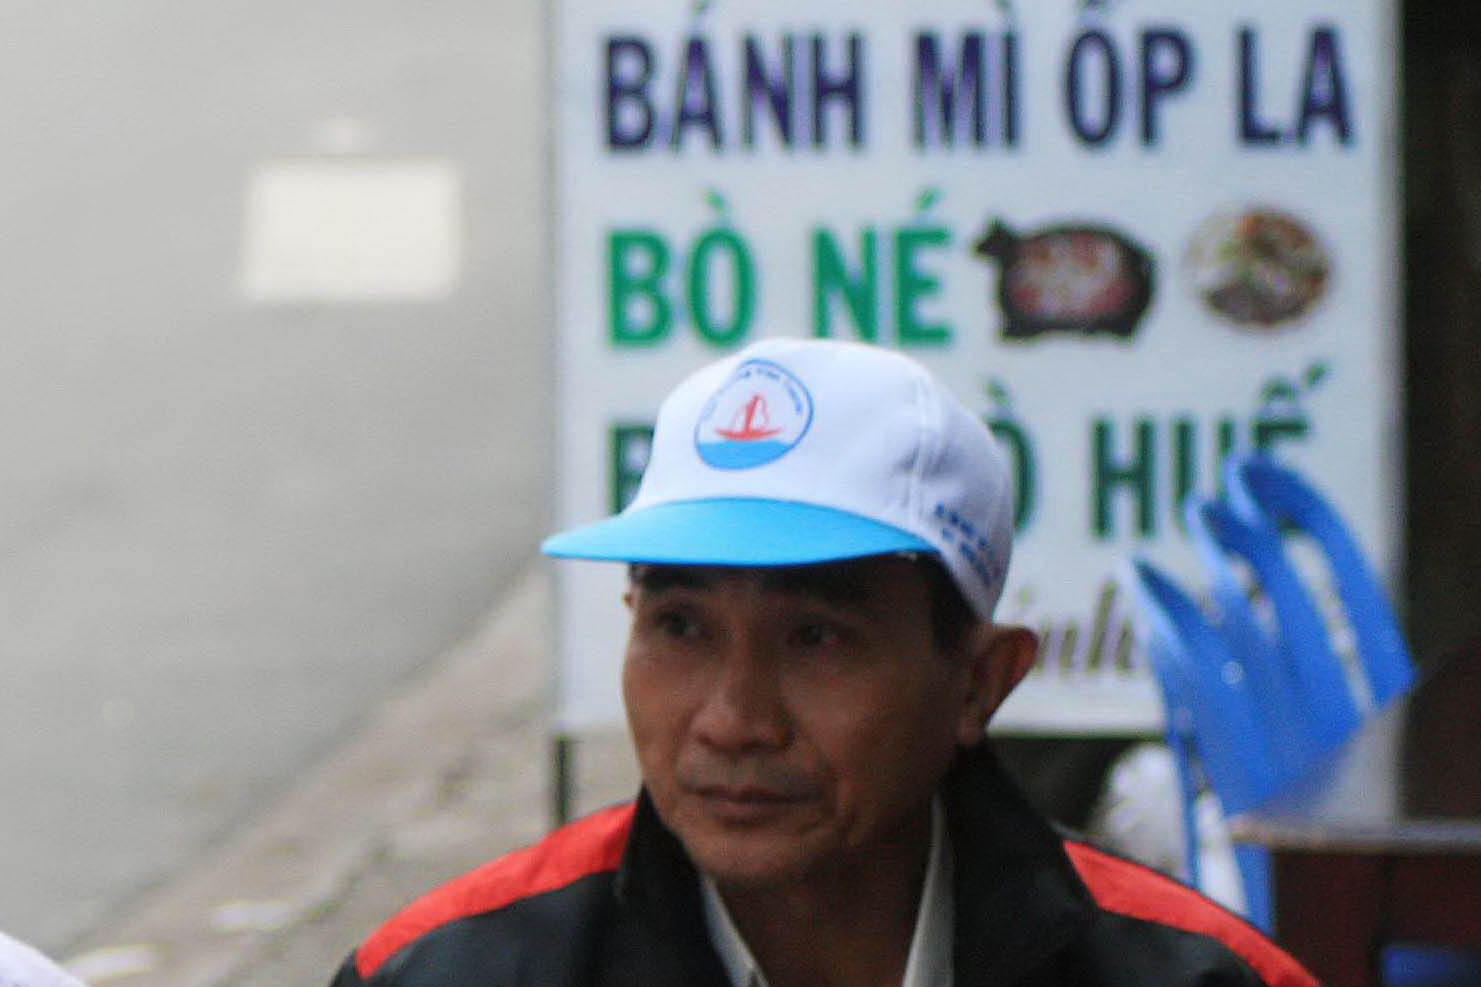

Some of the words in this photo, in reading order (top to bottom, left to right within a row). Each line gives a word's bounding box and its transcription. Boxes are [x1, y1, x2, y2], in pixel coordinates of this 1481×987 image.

[604, 0, 864, 154] BÁNH
[912, 0, 1020, 148] MÌ
[1234, 26, 1355, 148] LA
[607, 186, 756, 350] BÒ
[810, 186, 954, 348] NÉ
